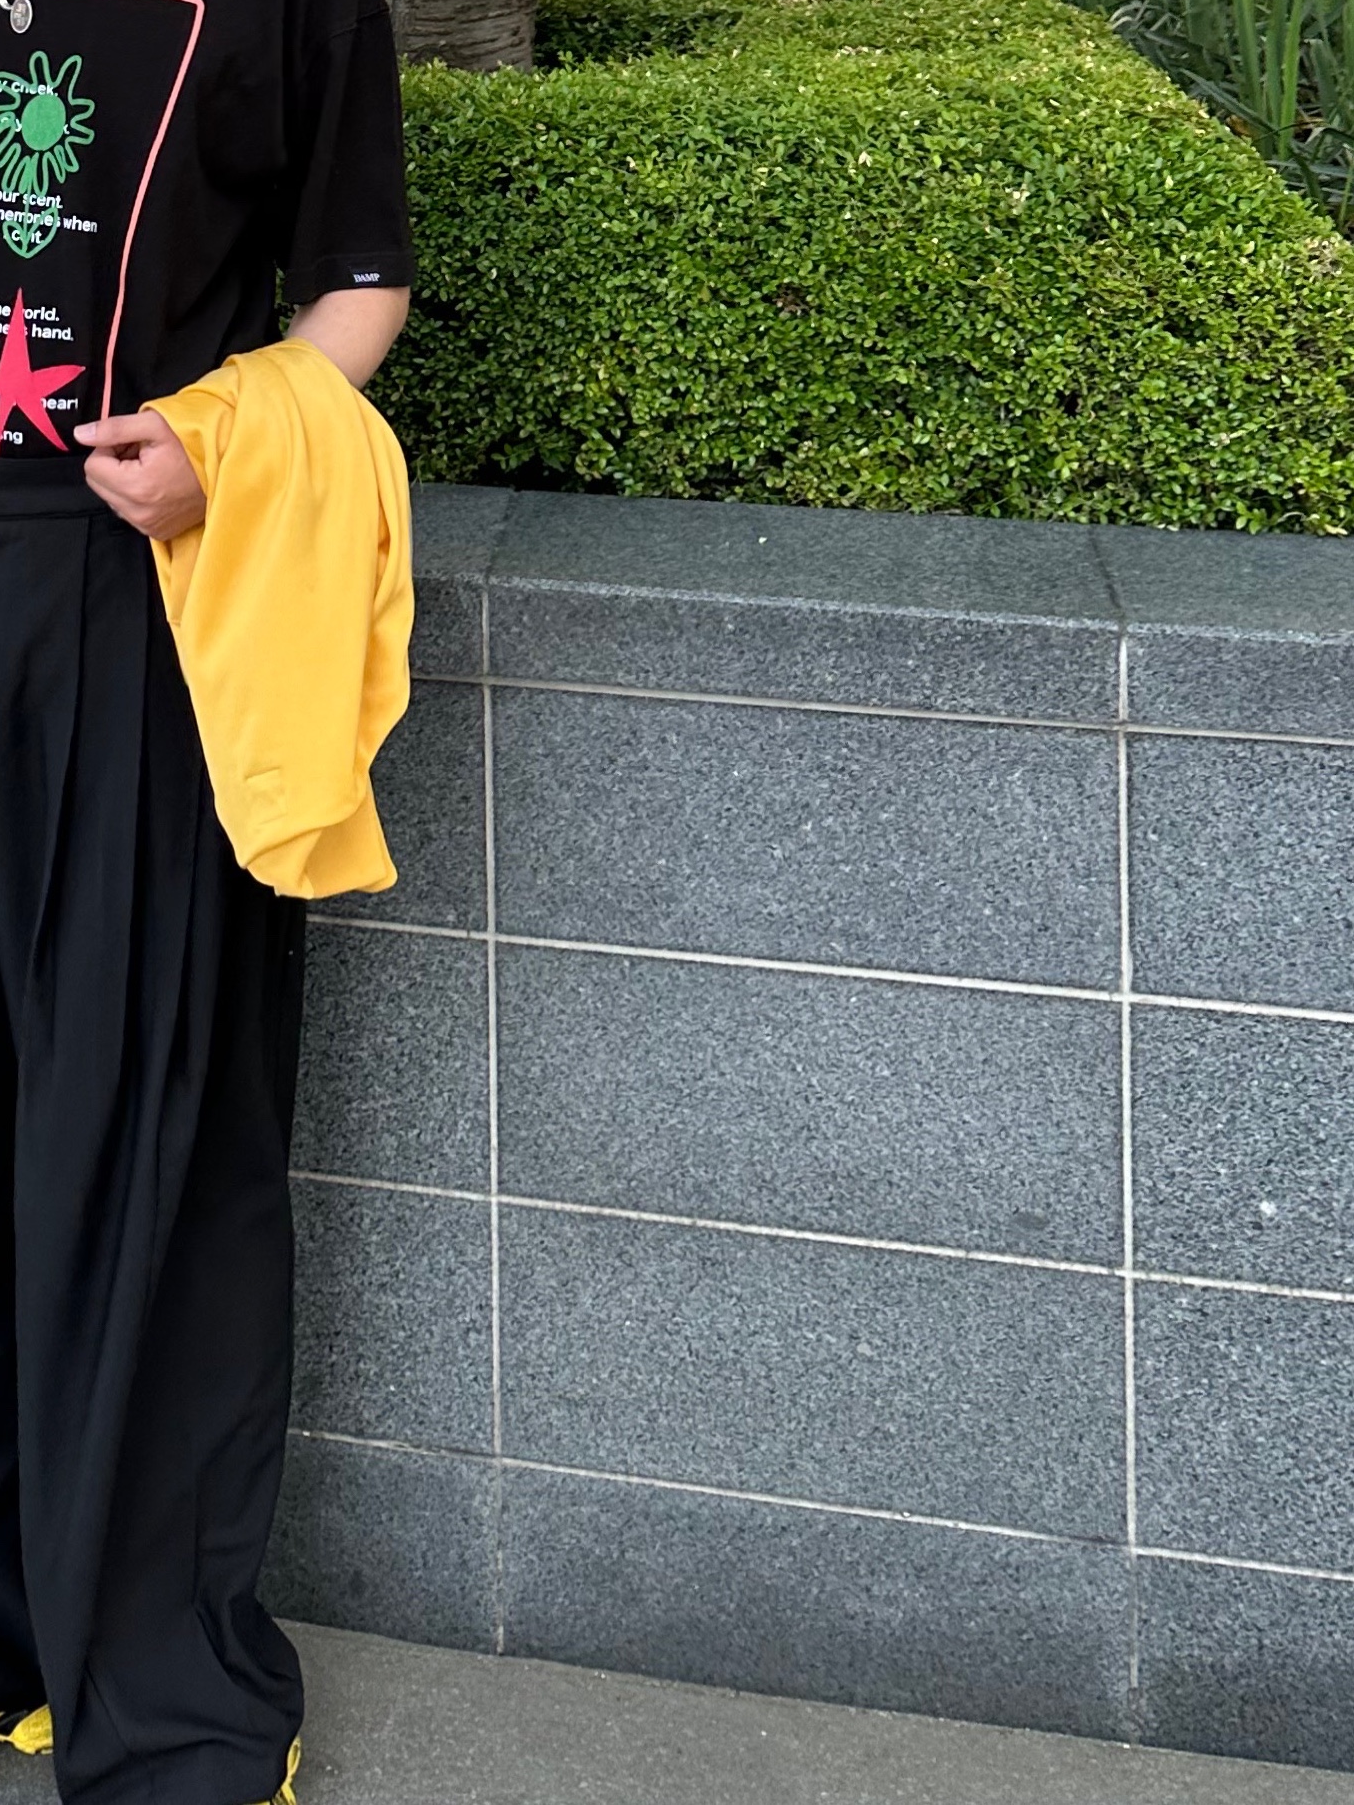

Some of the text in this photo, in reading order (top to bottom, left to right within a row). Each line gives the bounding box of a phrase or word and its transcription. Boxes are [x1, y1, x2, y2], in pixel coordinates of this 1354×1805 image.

[62, 215, 99, 233] when
[20, 306, 60, 322] orld.
[31, 323, 74, 342] hand.
